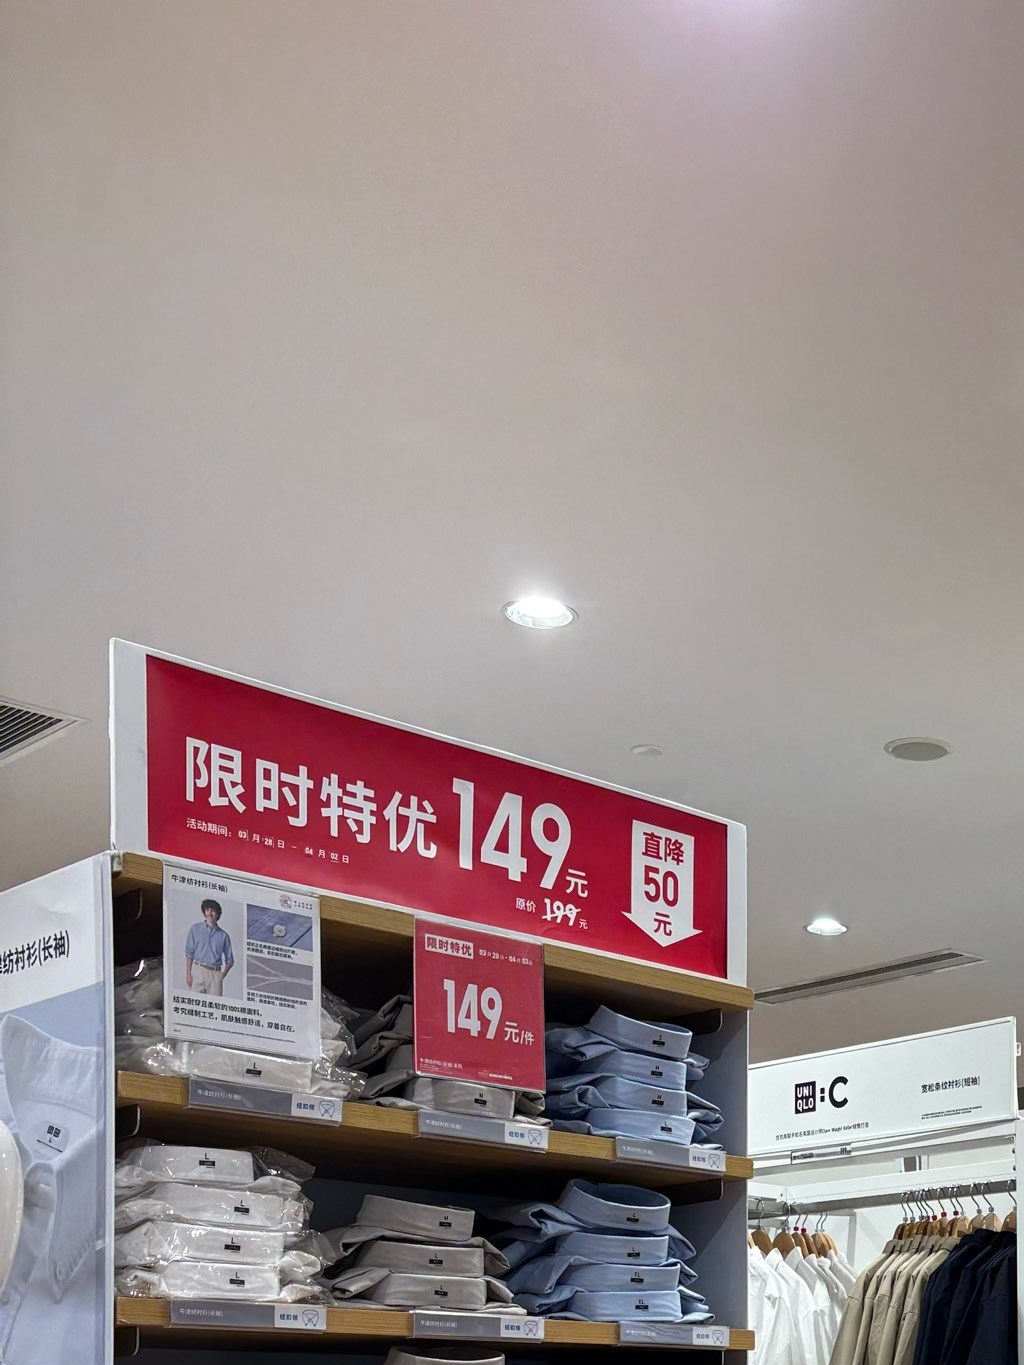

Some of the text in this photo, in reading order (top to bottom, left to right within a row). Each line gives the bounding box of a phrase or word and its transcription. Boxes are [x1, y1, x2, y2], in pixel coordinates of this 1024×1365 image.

[185, 736, 438, 859] 限时特优
[642, 832, 684, 866] 直降
[171, 873, 228, 894] 牛津纺衬衫(长袖)
[643, 864, 679, 908] 50
[515, 897, 537, 914] 原价
[653, 911, 673, 937] 元
[0, 930, 70, 976] 纺衬衫(长袖)
[427, 936, 472, 957] 限时特优
[796, 1084, 813, 1099] UNI
[920, 1075, 981, 1095] 宽松条纹衬衫(短袖)
[796, 1097, 815, 1112] QLO
